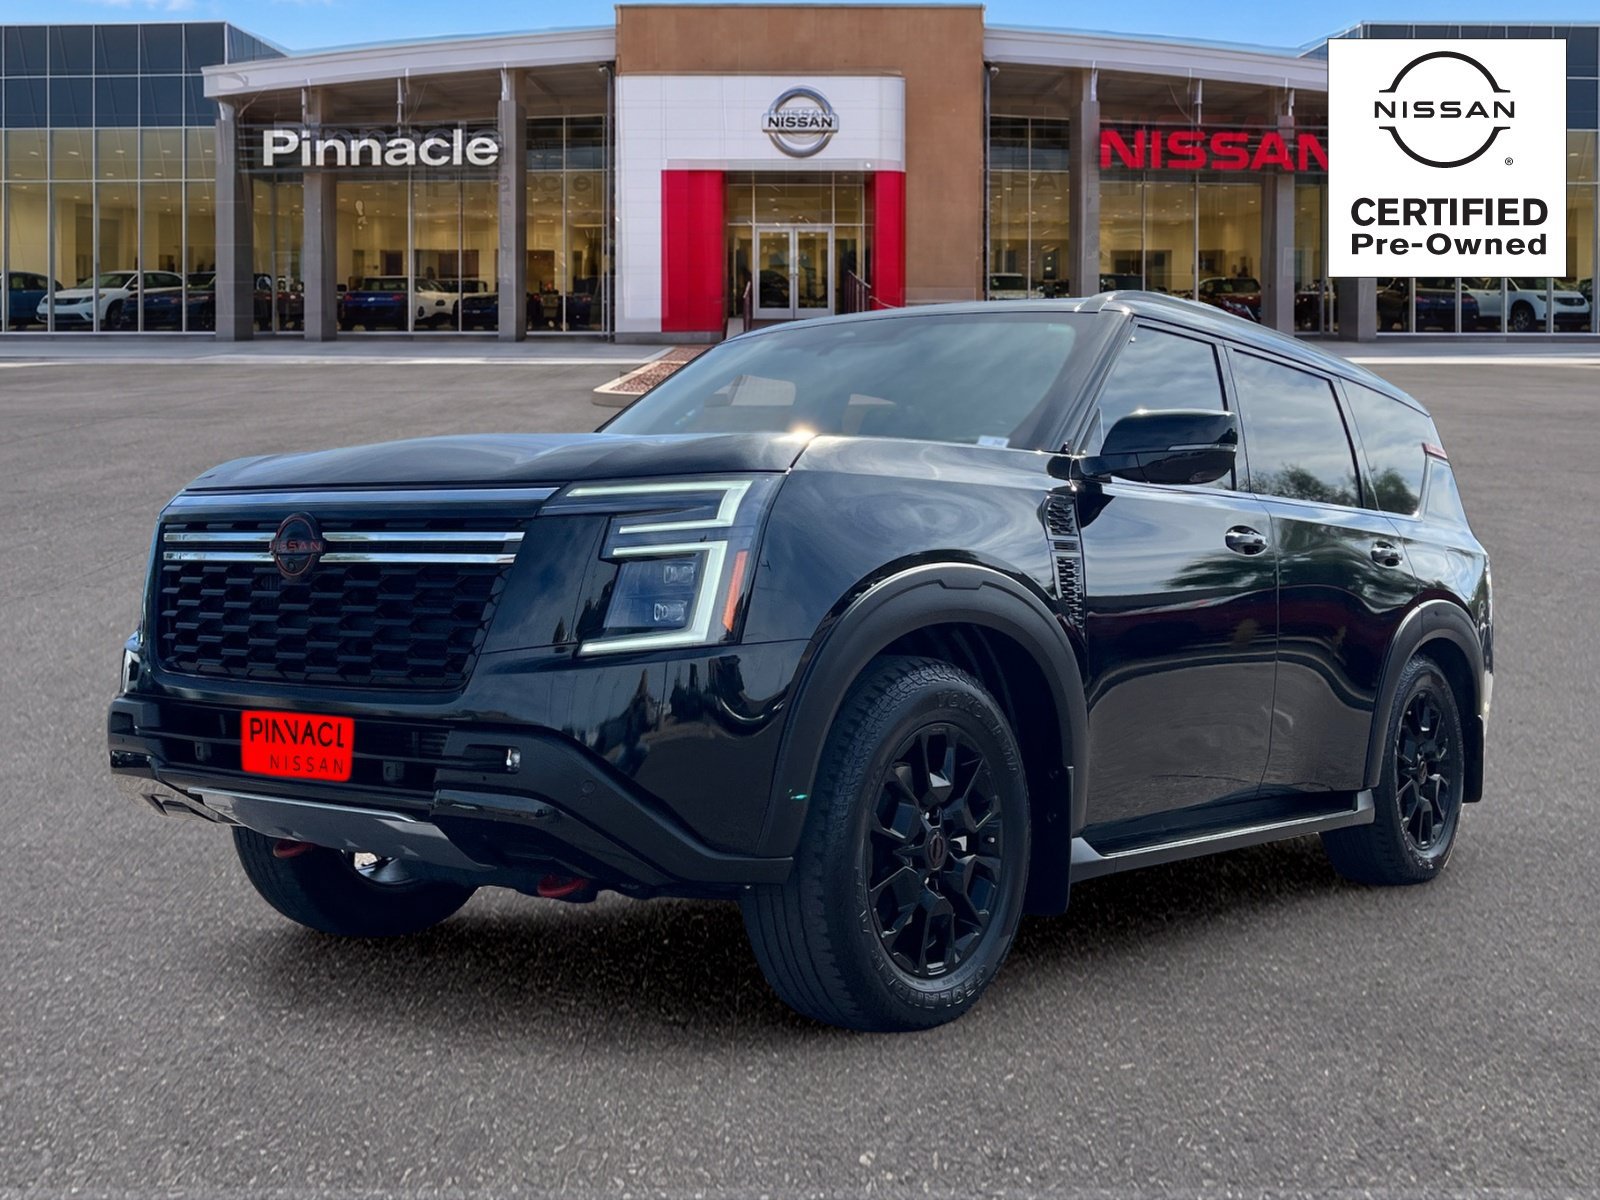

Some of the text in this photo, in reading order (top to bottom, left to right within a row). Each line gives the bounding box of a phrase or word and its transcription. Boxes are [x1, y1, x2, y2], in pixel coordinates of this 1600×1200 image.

[768, 116, 833, 128] NISSAN
[262, 129, 499, 166] Pinnacle
[269, 754, 344, 775] NISSAN
